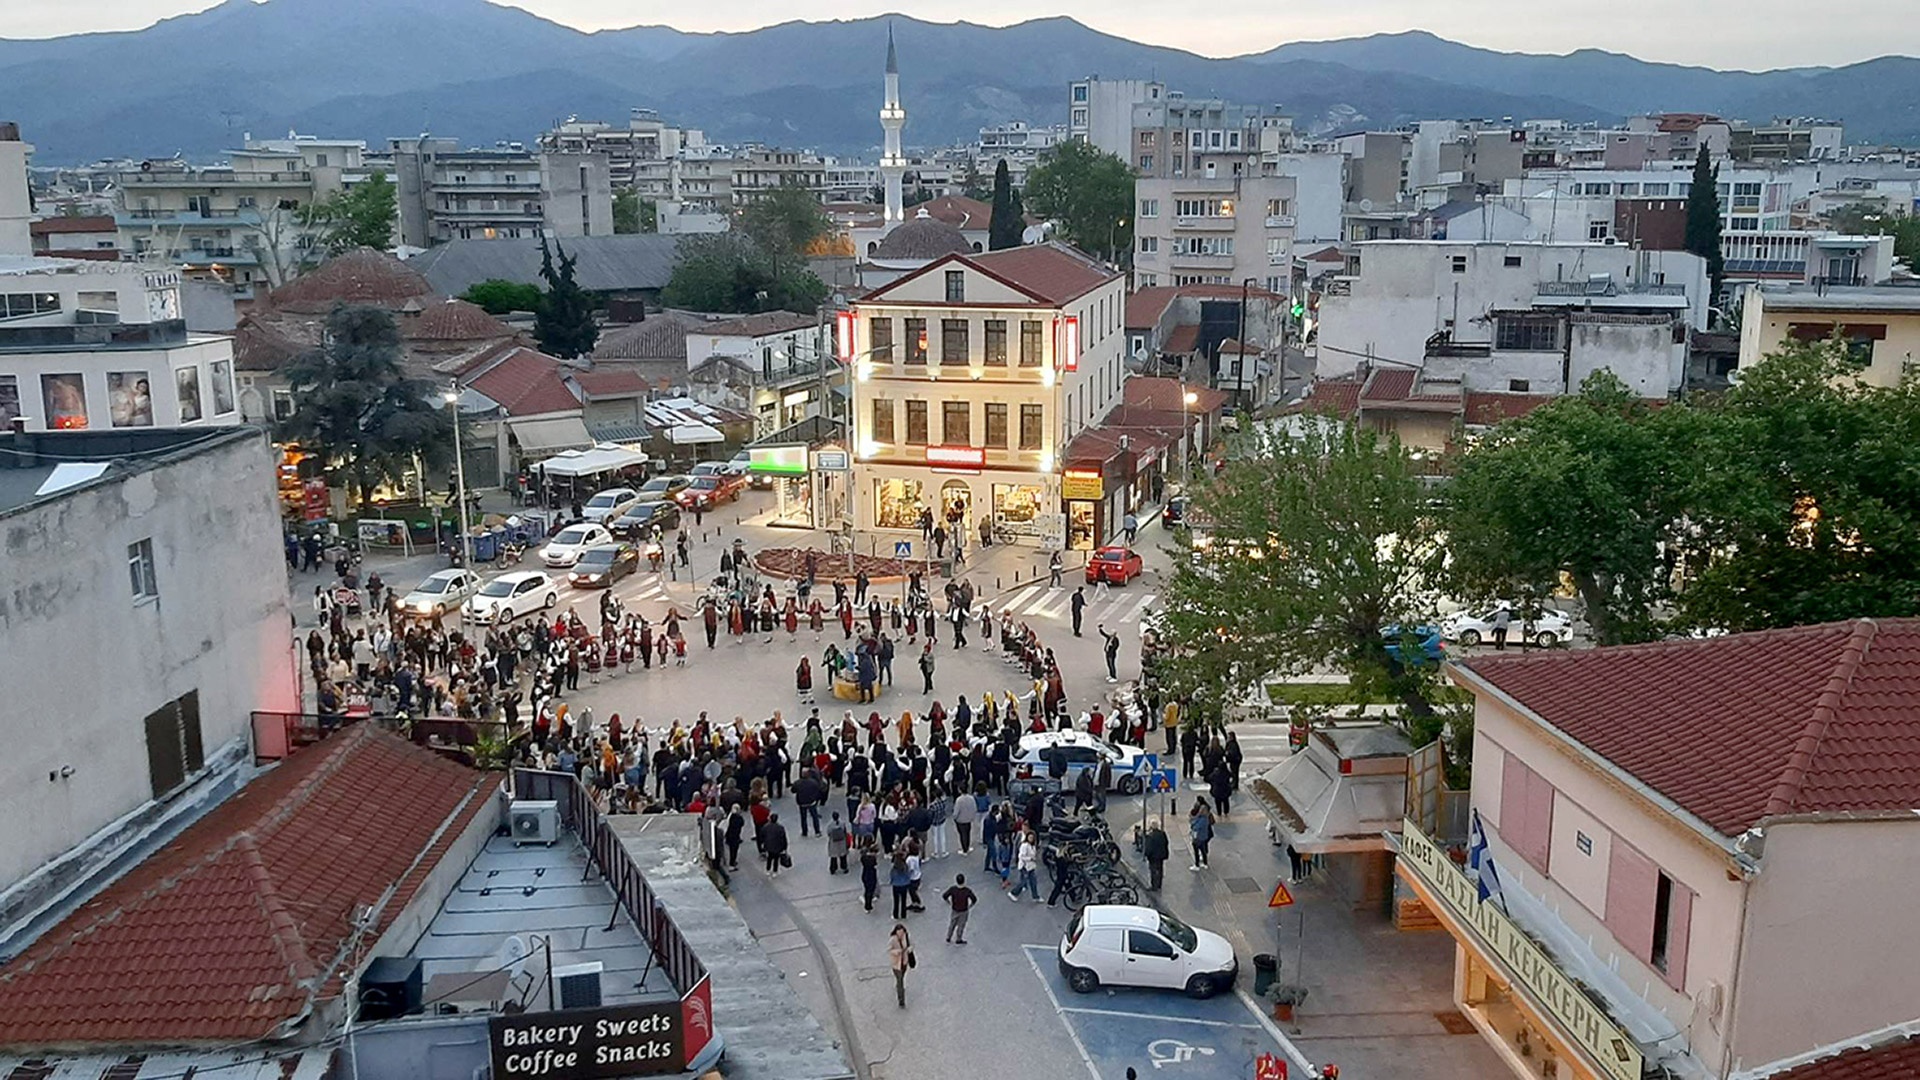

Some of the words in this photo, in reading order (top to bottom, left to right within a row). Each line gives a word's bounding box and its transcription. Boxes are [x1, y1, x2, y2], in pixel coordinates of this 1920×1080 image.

[1436, 861, 1499, 943] ΒΑΣΙΛΗ
[1508, 935, 1600, 1051] ΚΕΚΚΕΡΗ
[503, 1024, 583, 1047] Bakery
[595, 1013, 671, 1039] Sweets
[505, 1050, 578, 1075] Coffee
[595, 1040, 672, 1065] Snacks
